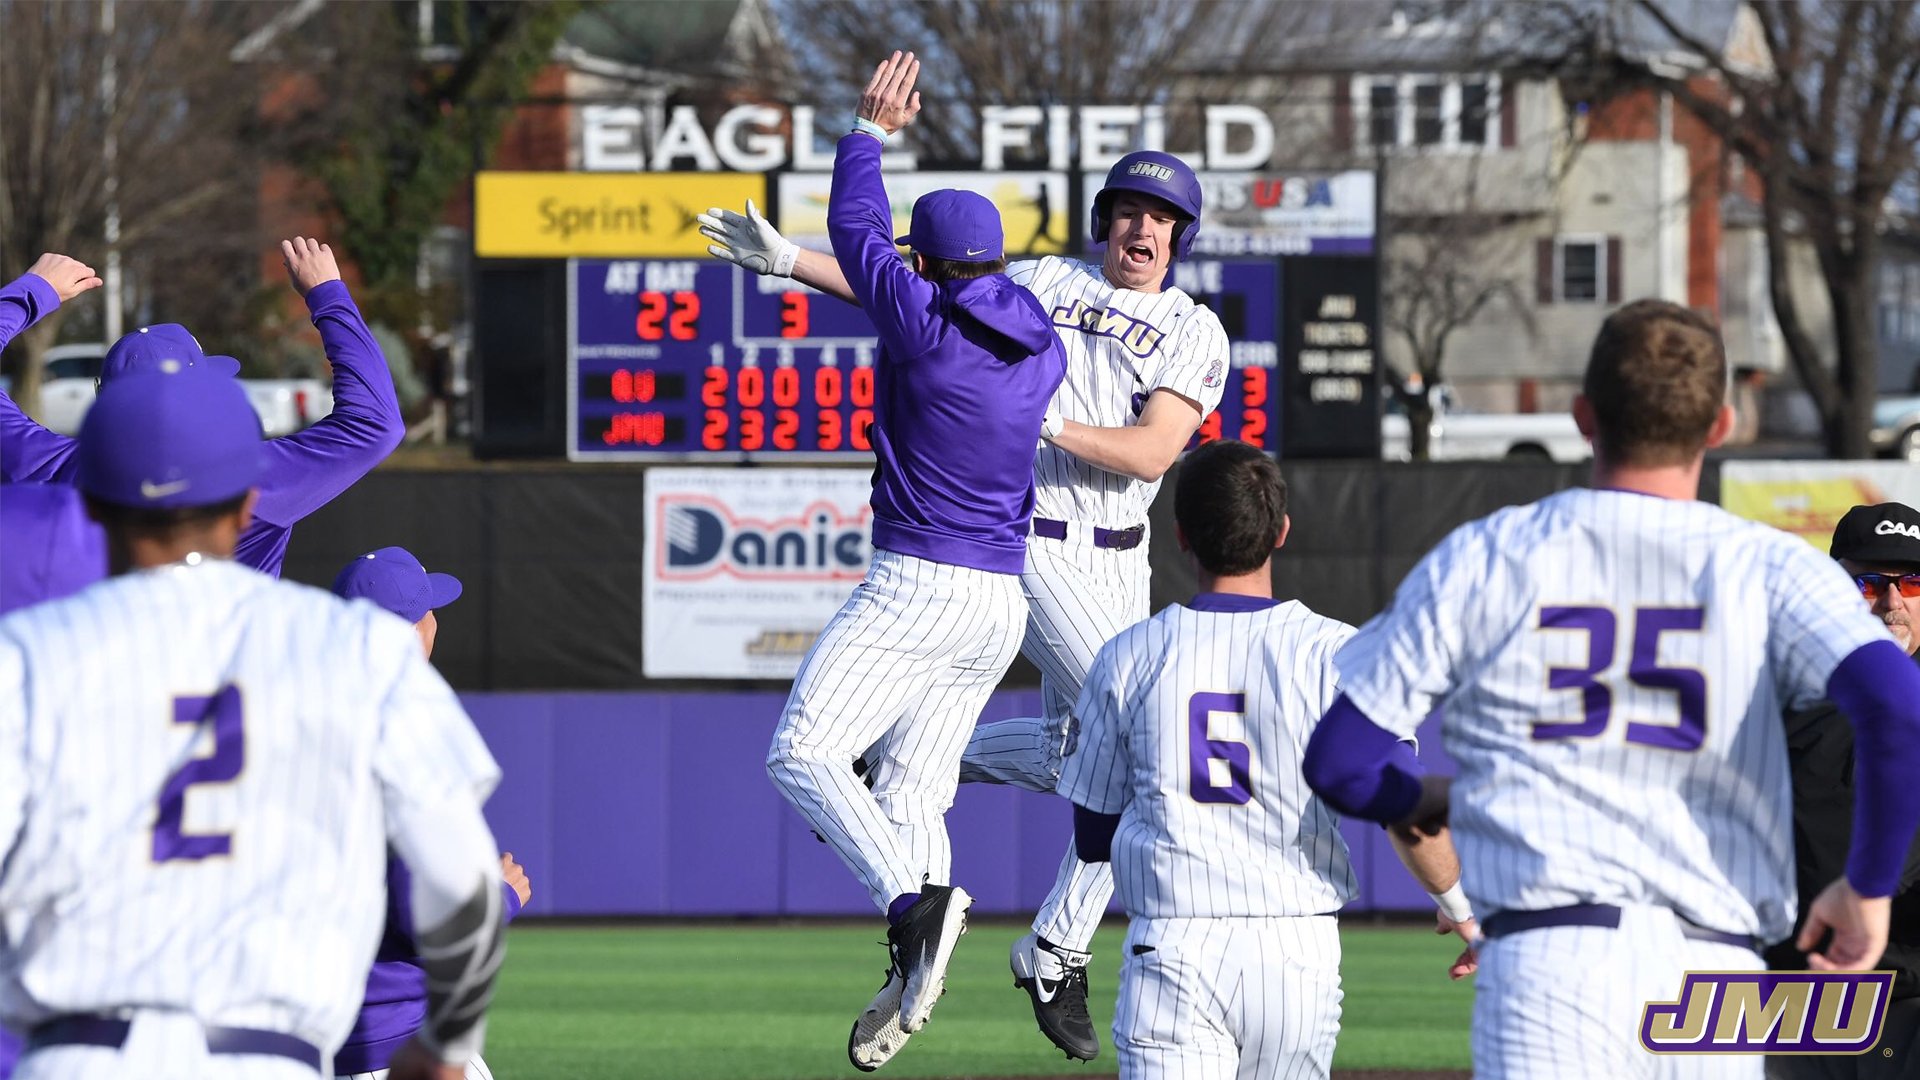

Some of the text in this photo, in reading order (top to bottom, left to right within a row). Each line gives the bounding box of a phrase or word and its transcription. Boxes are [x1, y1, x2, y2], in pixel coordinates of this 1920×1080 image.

[982, 104, 1274, 171] FIELD
[1128, 161, 1174, 182] JMU
[538, 196, 651, 242] Sprint
[604, 261, 699, 293] AT BAT
[636, 291, 700, 340] 22
[781, 291, 808, 339] 3
[1051, 299, 1166, 358] JMU
[710, 342, 724, 367] 1
[742, 342, 759, 367] 2
[776, 342, 794, 367] 3
[702, 366, 728, 407] 2
[737, 366, 764, 407] 0
[772, 366, 799, 407] 0
[815, 366, 842, 407] 0
[1243, 365, 1267, 407] 3
[602, 412, 664, 445] JMU
[702, 409, 728, 450] 2
[740, 409, 764, 450] 3
[772, 409, 799, 450] 2
[817, 409, 842, 450] 3
[1240, 408, 1267, 448] 2
[1874, 519, 1920, 540] CAA
[1530, 606, 1708, 753] 35
[1187, 690, 1252, 806] 6
[151, 681, 245, 864] 2
